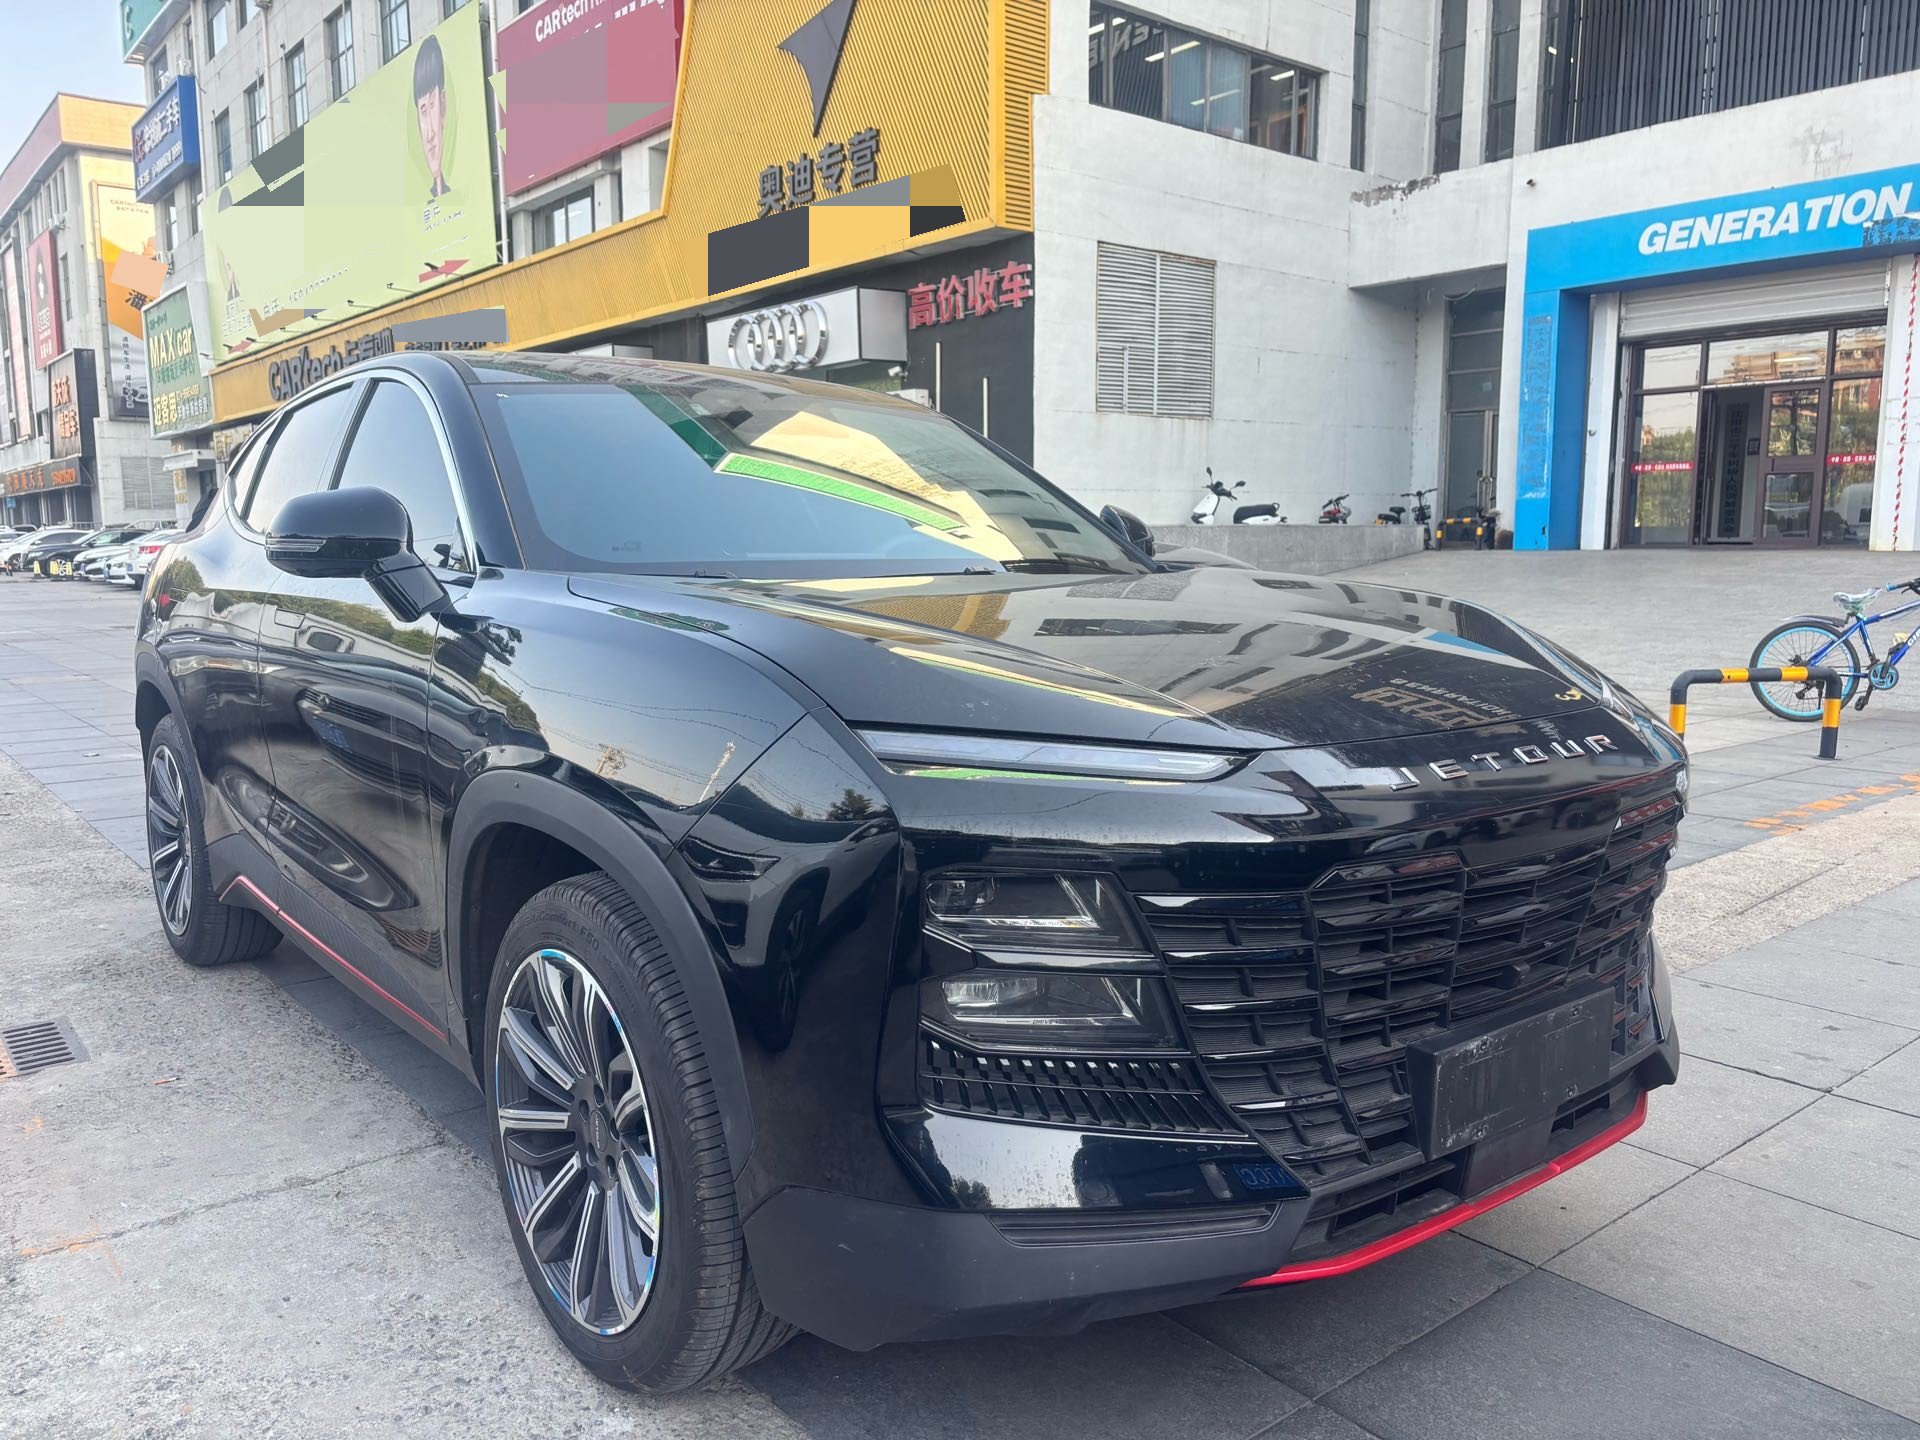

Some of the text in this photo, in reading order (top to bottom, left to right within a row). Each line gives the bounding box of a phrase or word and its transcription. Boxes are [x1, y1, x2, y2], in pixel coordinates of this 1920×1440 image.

[757, 127, 880, 216] 奥迪专营
[1638, 182, 1913, 256] GENERATION
[908, 261, 1033, 330] 高价收车
[149, 327, 176, 369] MAX
[176, 326, 193, 357] car
[1390, 734, 1619, 791] JETOUR
